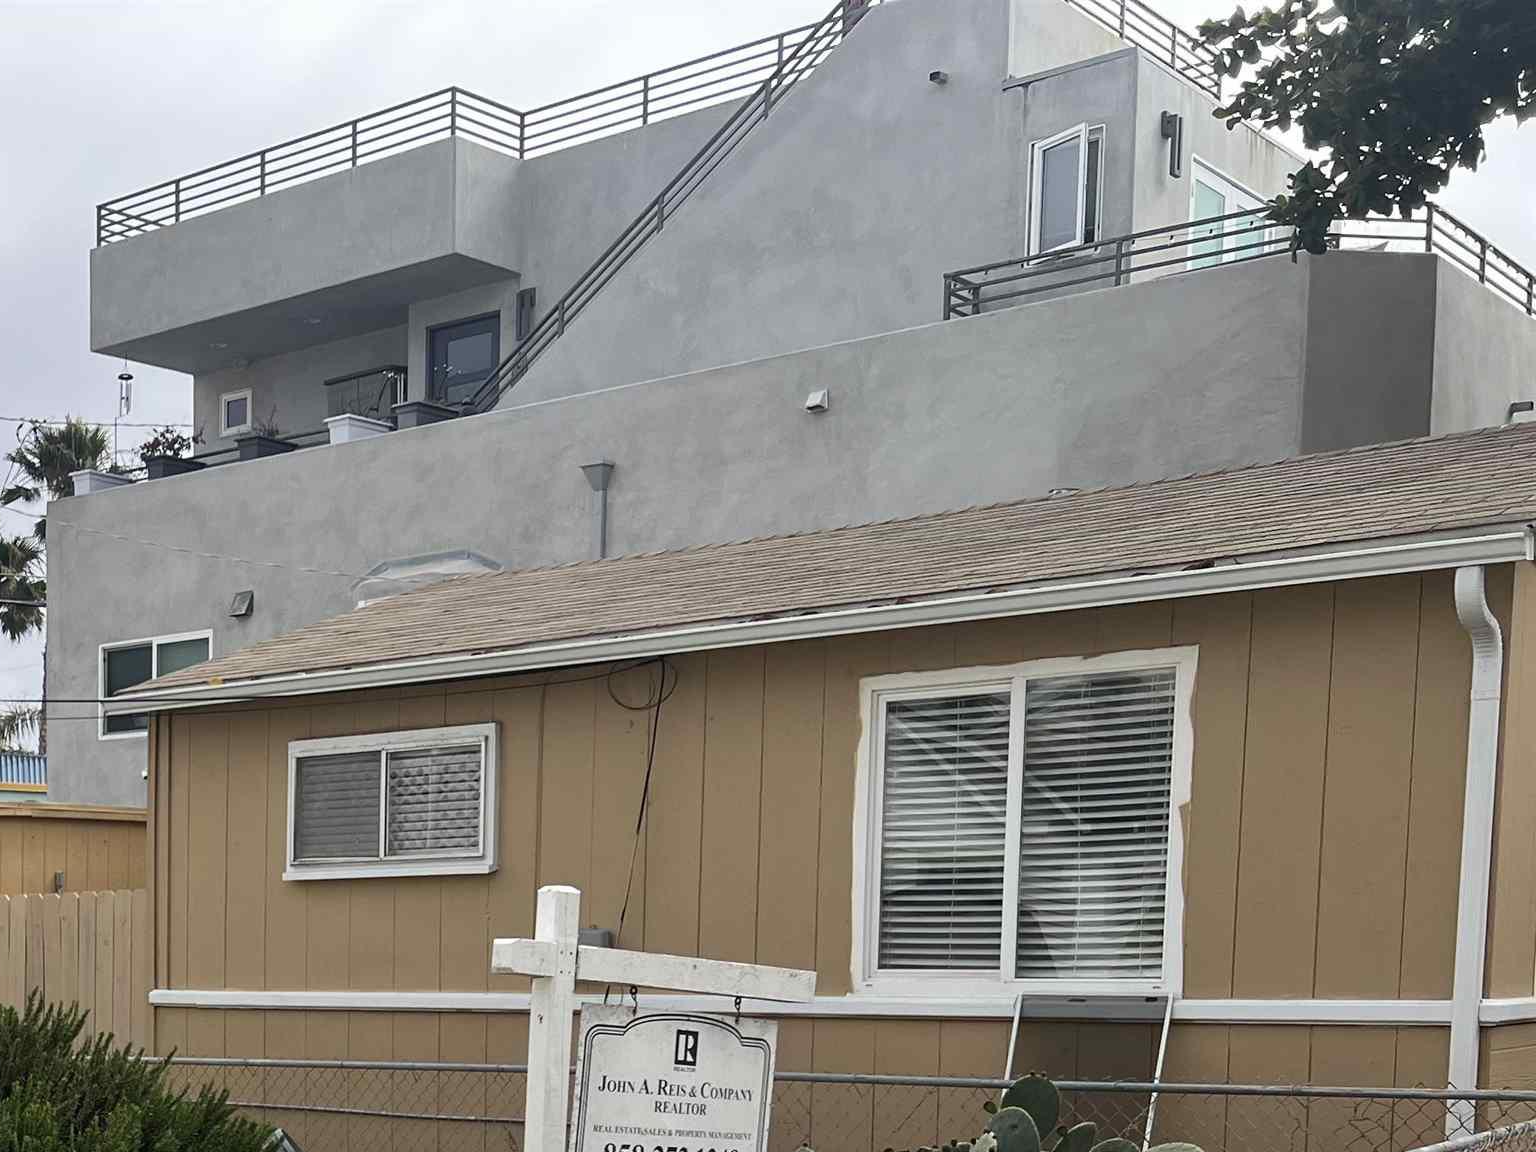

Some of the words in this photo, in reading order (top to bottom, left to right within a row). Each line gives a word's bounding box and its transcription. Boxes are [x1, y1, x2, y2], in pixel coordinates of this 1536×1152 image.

[598, 1075, 635, 1093] JOHN
[638, 1078, 654, 1095] A.
[658, 1079, 686, 1097] REIS
[688, 1086, 698, 1098] &
[700, 1081, 753, 1102] COMPANY
[654, 1100, 707, 1116] REALTOR
[592, 1124, 613, 1134] REAL
[642, 1127, 667, 1137] SALES
[674, 1129, 707, 1139] PROPERTY
[708, 1131, 752, 1141] MANAGEMENT
